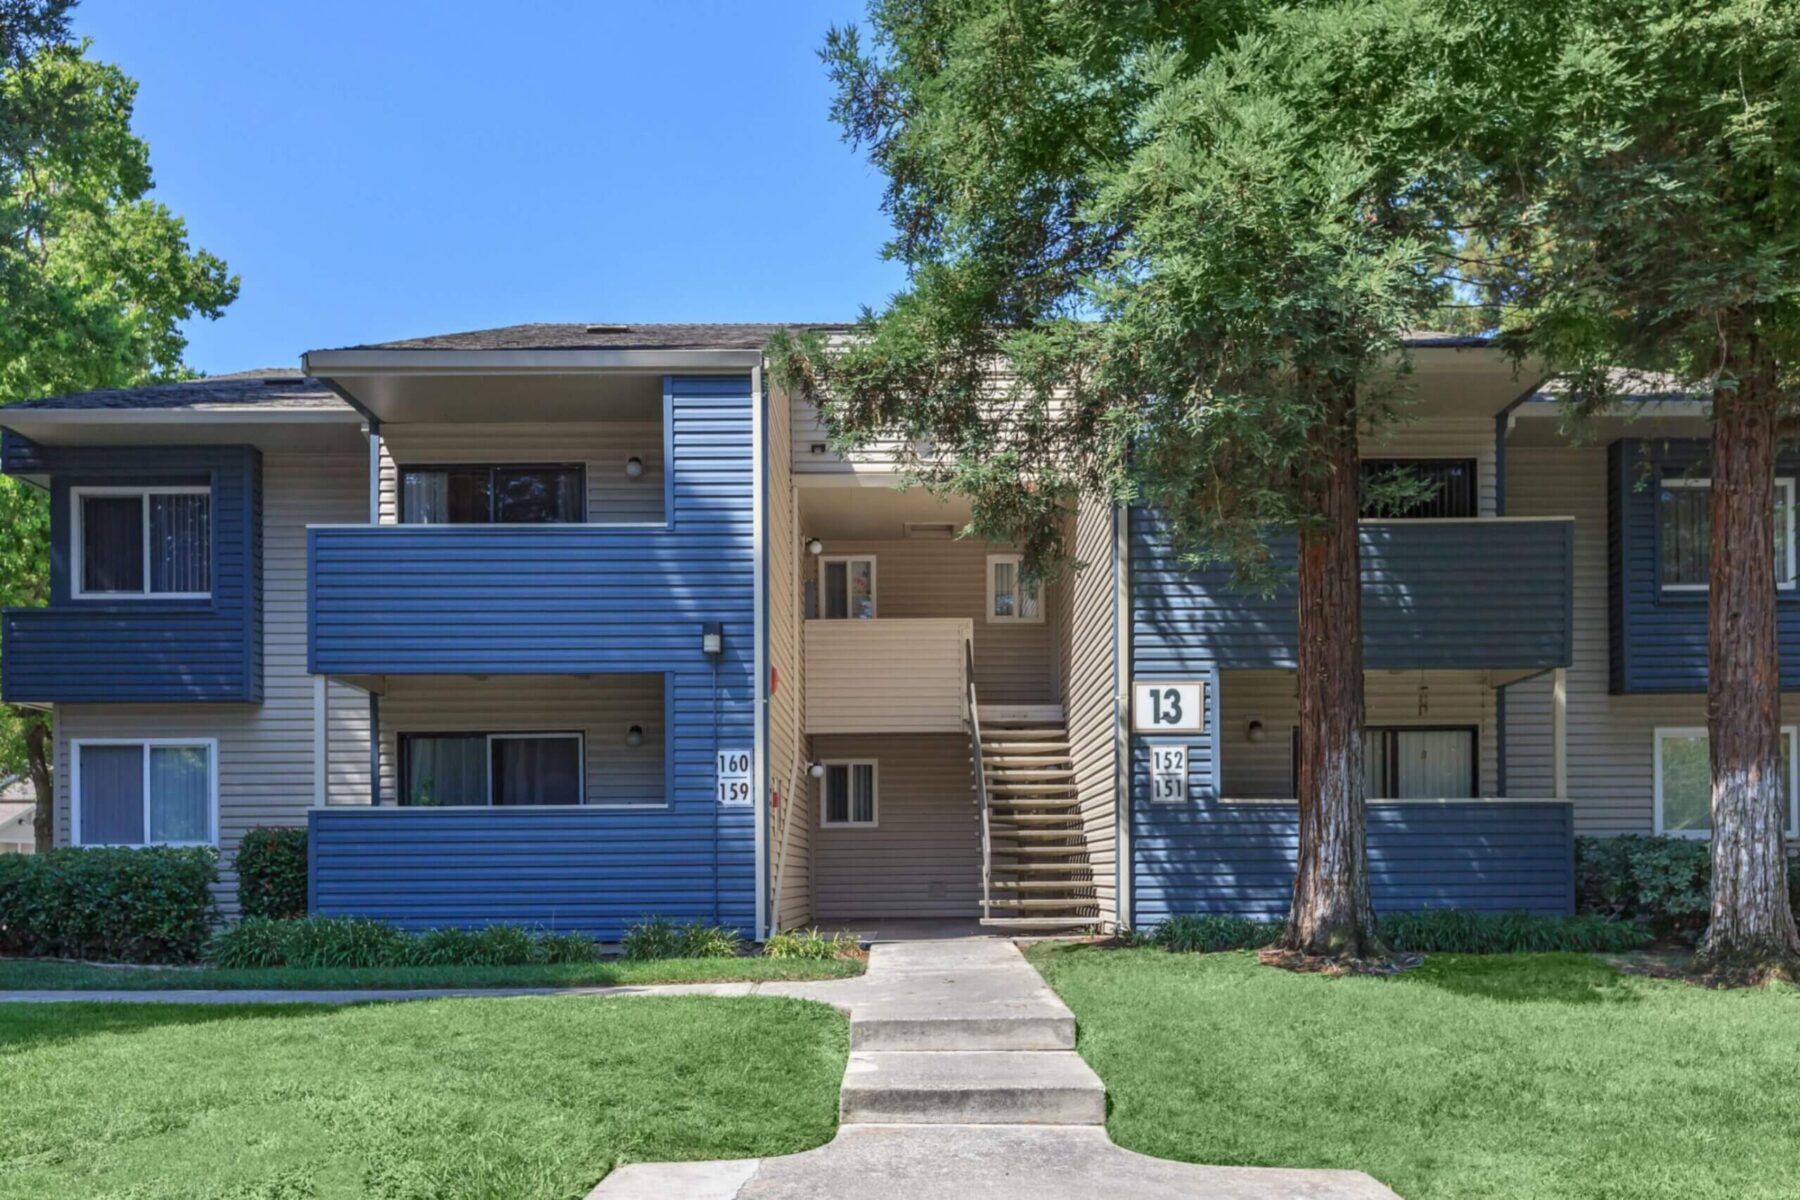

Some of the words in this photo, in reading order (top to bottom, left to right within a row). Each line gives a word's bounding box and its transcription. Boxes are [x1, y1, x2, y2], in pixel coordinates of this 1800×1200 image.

[1150, 688, 1183, 725] 13
[720, 755, 749, 773] 160
[1154, 751, 1183, 770] 152
[720, 783, 749, 801] 159
[1155, 779, 1182, 798] 151
